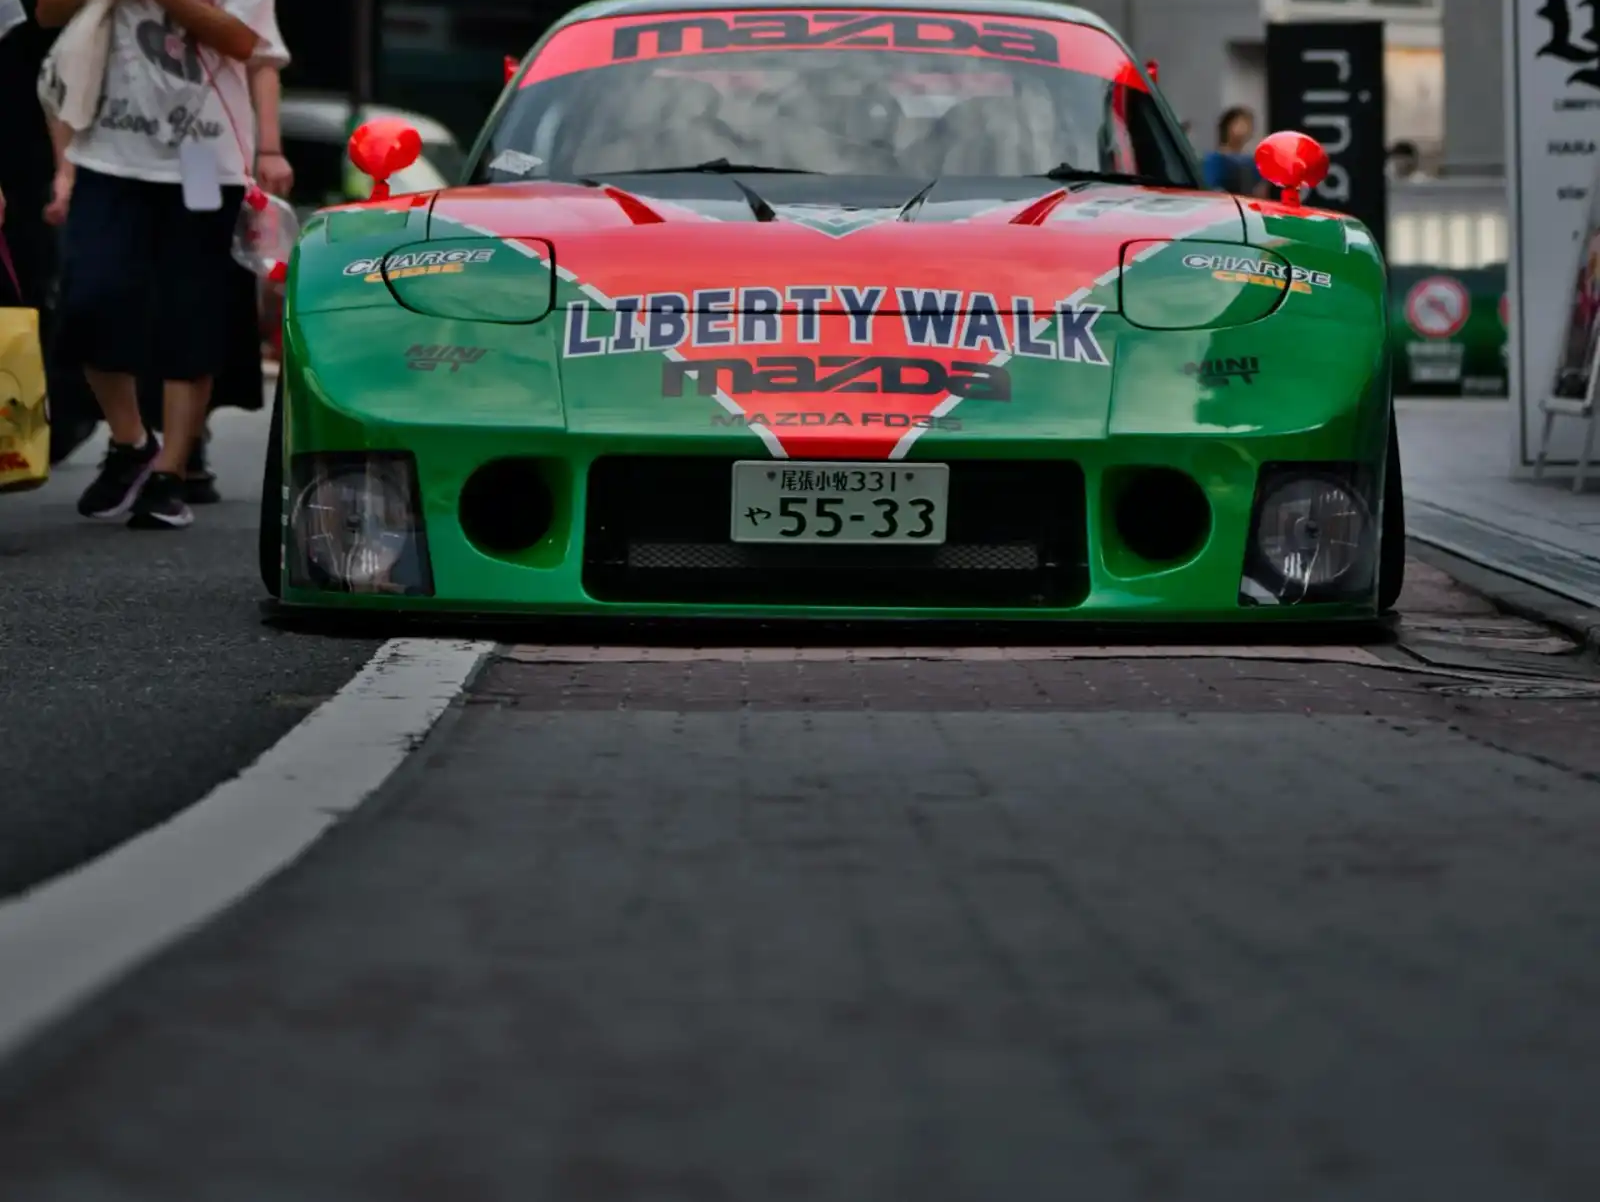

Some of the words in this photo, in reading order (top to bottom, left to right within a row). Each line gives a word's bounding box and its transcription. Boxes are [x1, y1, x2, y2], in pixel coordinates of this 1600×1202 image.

[612, 13, 1060, 63] mazda
[342, 248, 496, 276] CHARGE
[1182, 254, 1332, 288] CHARGE
[562, 285, 886, 358] LIBERTY
[895, 286, 1111, 365] WALK
[404, 343, 487, 362] MINI
[661, 354, 1012, 403] mazda
[710, 412, 854, 427] MAZDA
[744, 506, 772, 526] や
[779, 497, 935, 538] 55-33
